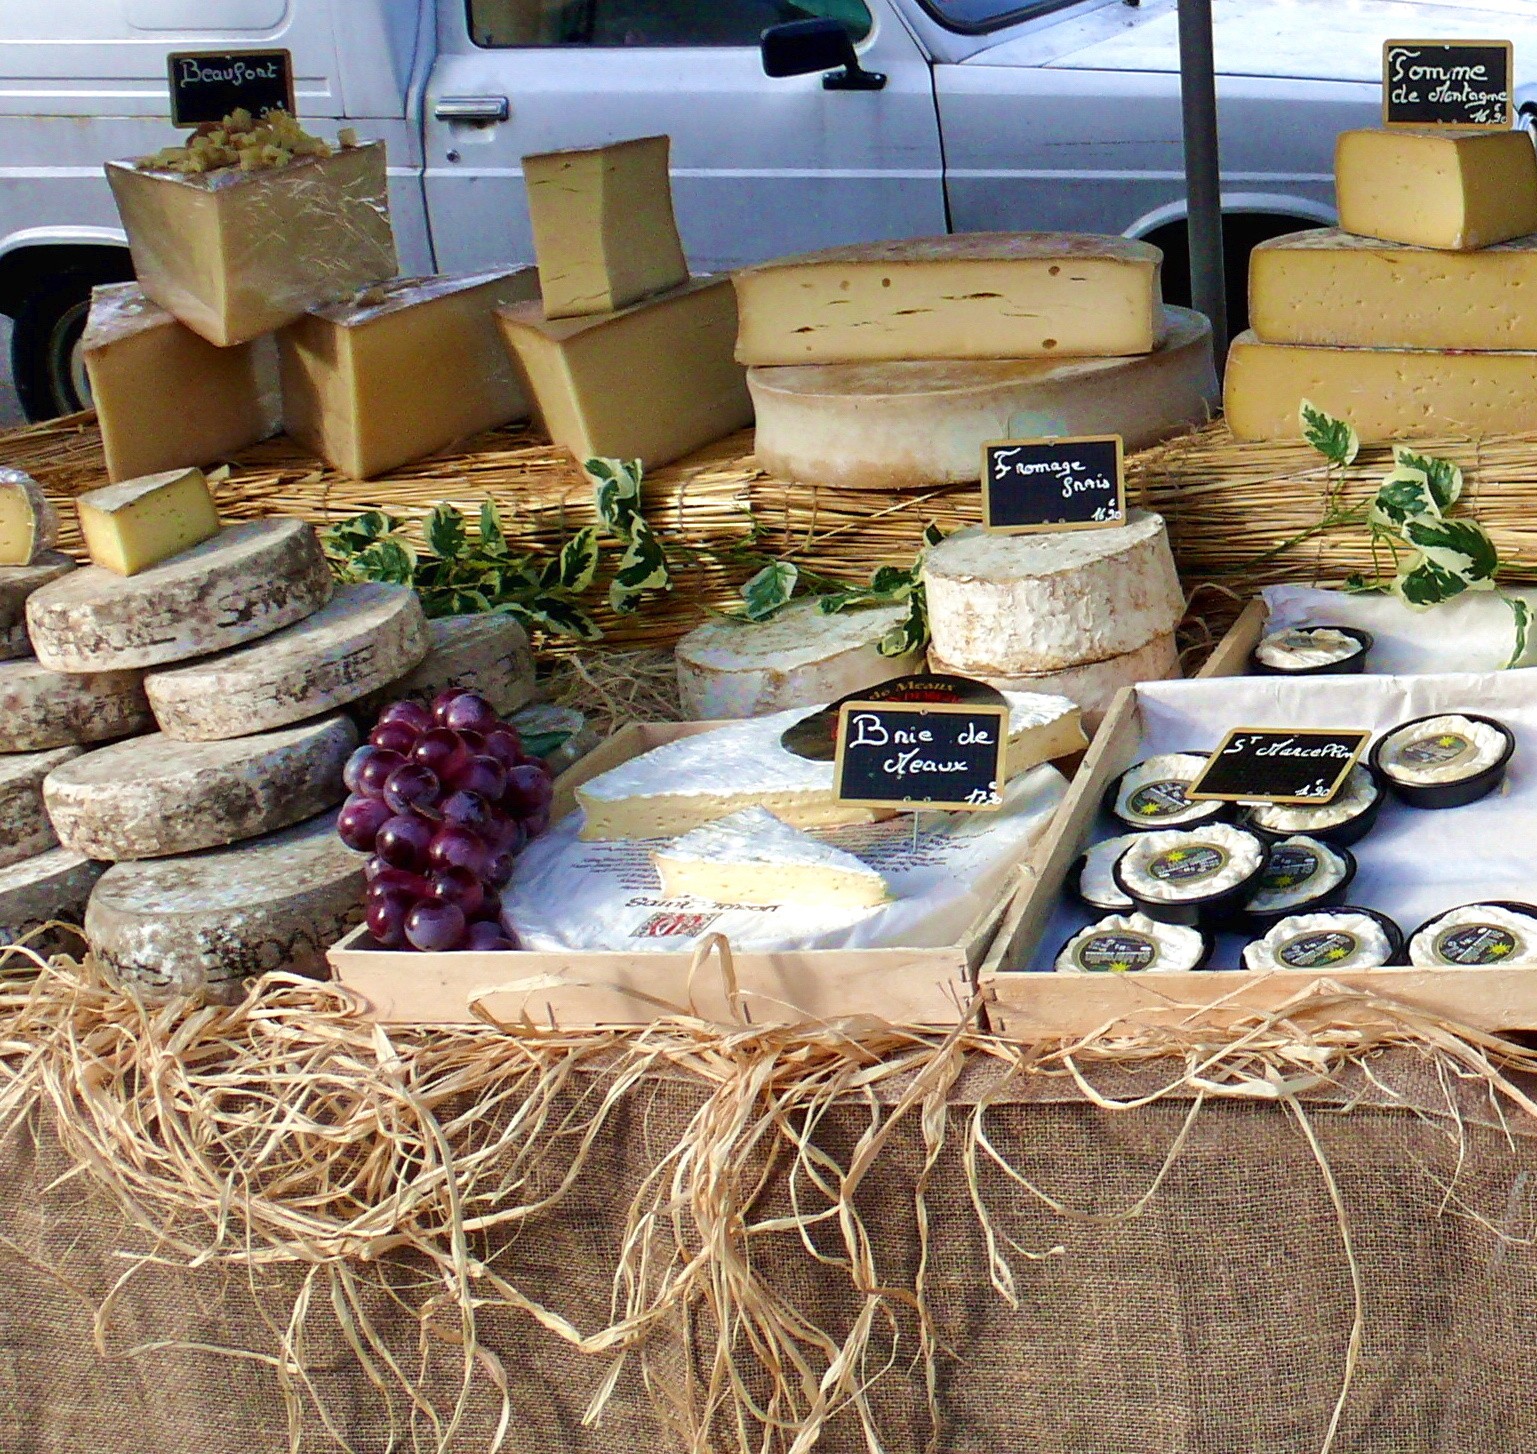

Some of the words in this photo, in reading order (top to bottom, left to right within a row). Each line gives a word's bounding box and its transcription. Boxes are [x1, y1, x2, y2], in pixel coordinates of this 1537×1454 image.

[179, 58, 278, 88] Beaufort
[1388, 48, 1489, 83] Tomme
[1391, 84, 1421, 104] de
[1428, 80, 1509, 109] Montagne
[993, 447, 1087, 480] Fromage
[1062, 473, 1111, 498] frais
[849, 714, 934, 749] Brie
[958, 722, 995, 745] de
[883, 748, 969, 775] Meaux
